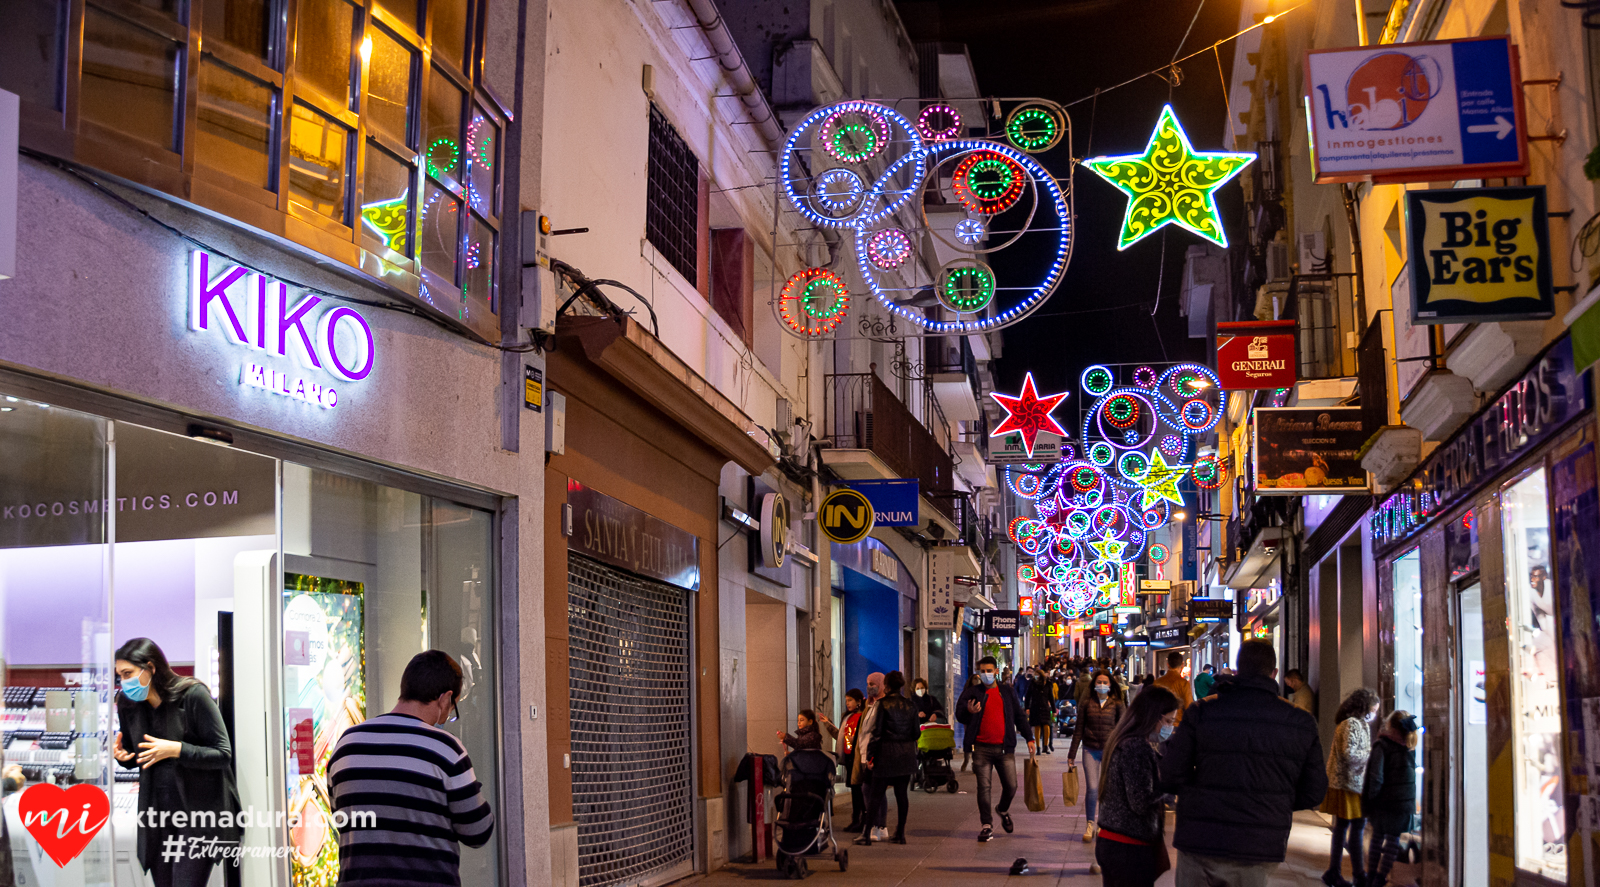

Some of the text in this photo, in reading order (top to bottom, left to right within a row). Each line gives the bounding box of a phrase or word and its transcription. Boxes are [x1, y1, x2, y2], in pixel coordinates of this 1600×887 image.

[1327, 135, 1443, 149] inmogestiones
[1439, 209, 1522, 255] Big
[1429, 249, 1534, 285] Ears
[192, 250, 375, 381] KIKO
[1231, 360, 1286, 371] GENERALI
[1245, 371, 1273, 379] Seguros
[243, 362, 338, 410] MILANO
[1323, 477, 1343, 486] Quesos
[1348, 476, 1363, 485] Vinos
[825, 504, 865, 529] IN
[873, 511, 913, 522] RNUM
[584, 509, 629, 562] SANTA
[992, 616, 1016, 624] Phone
